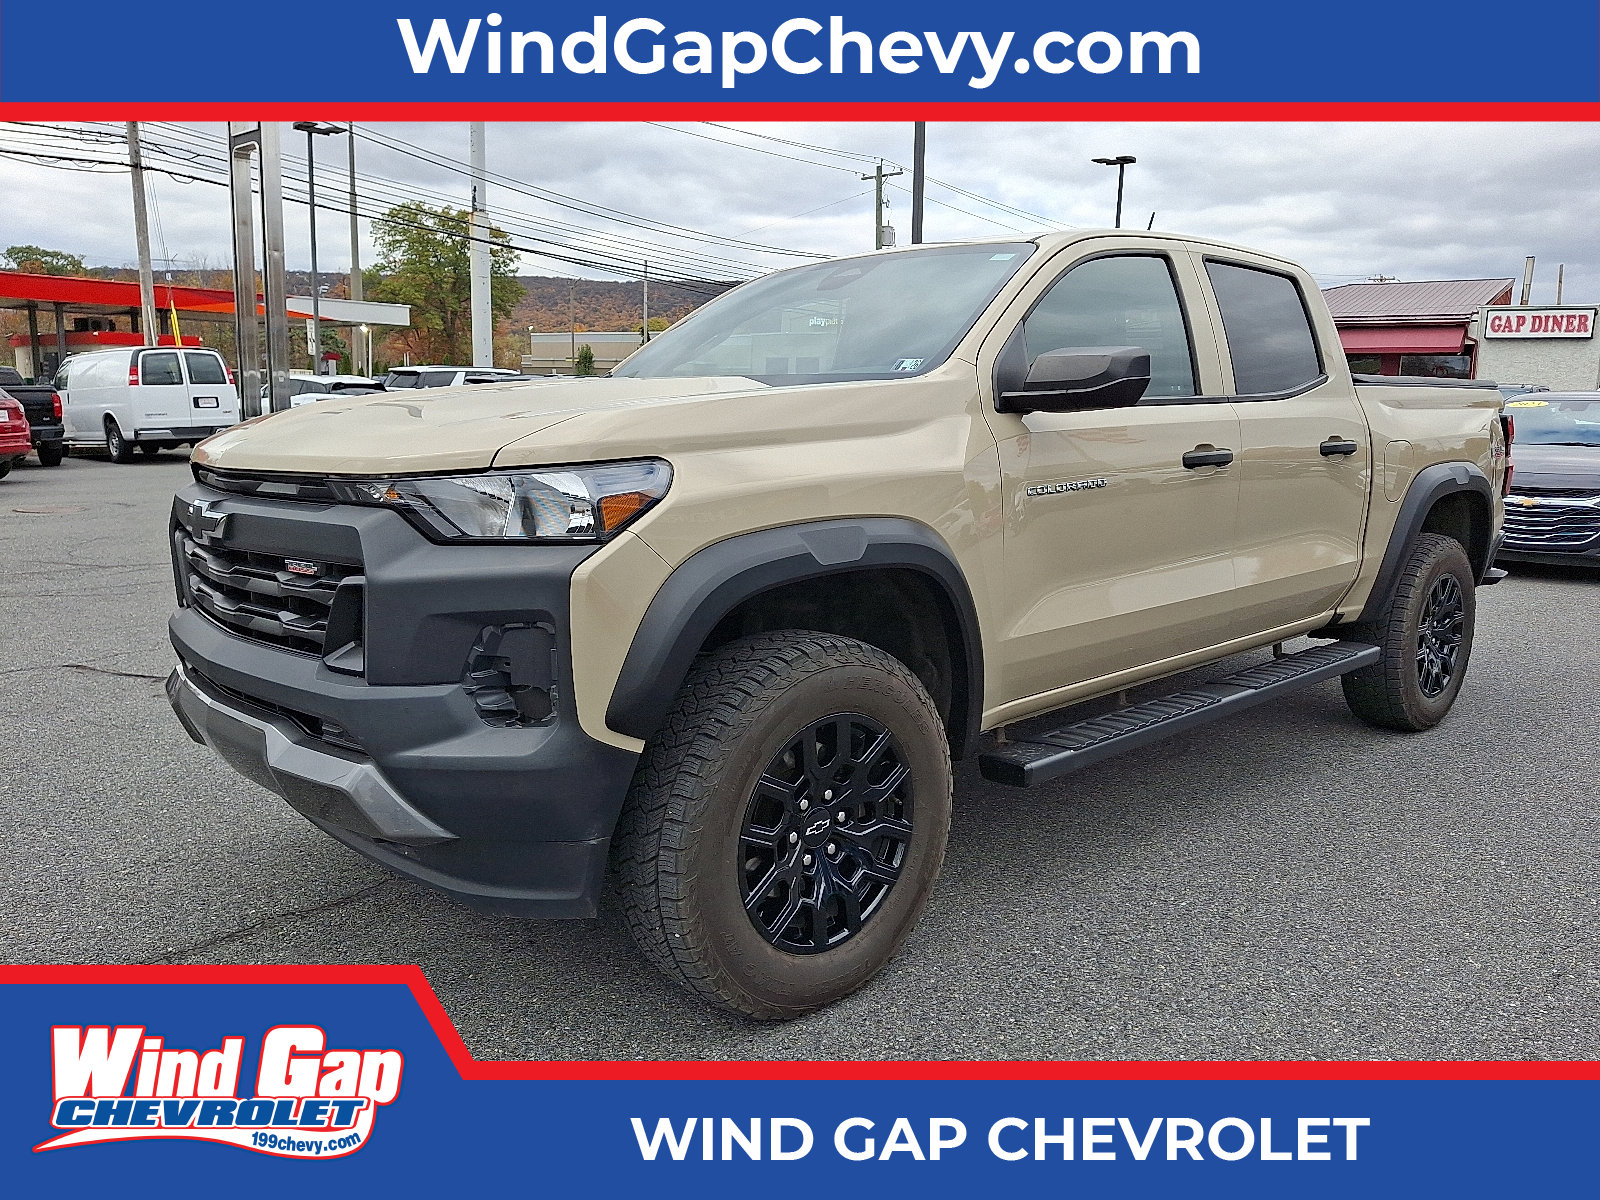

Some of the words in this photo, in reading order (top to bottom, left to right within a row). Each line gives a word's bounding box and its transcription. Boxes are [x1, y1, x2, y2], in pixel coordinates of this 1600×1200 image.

[1490, 315, 1527, 333] GAP
[1529, 314, 1590, 333] DINER
[1027, 478, 1107, 496] COLORADO
